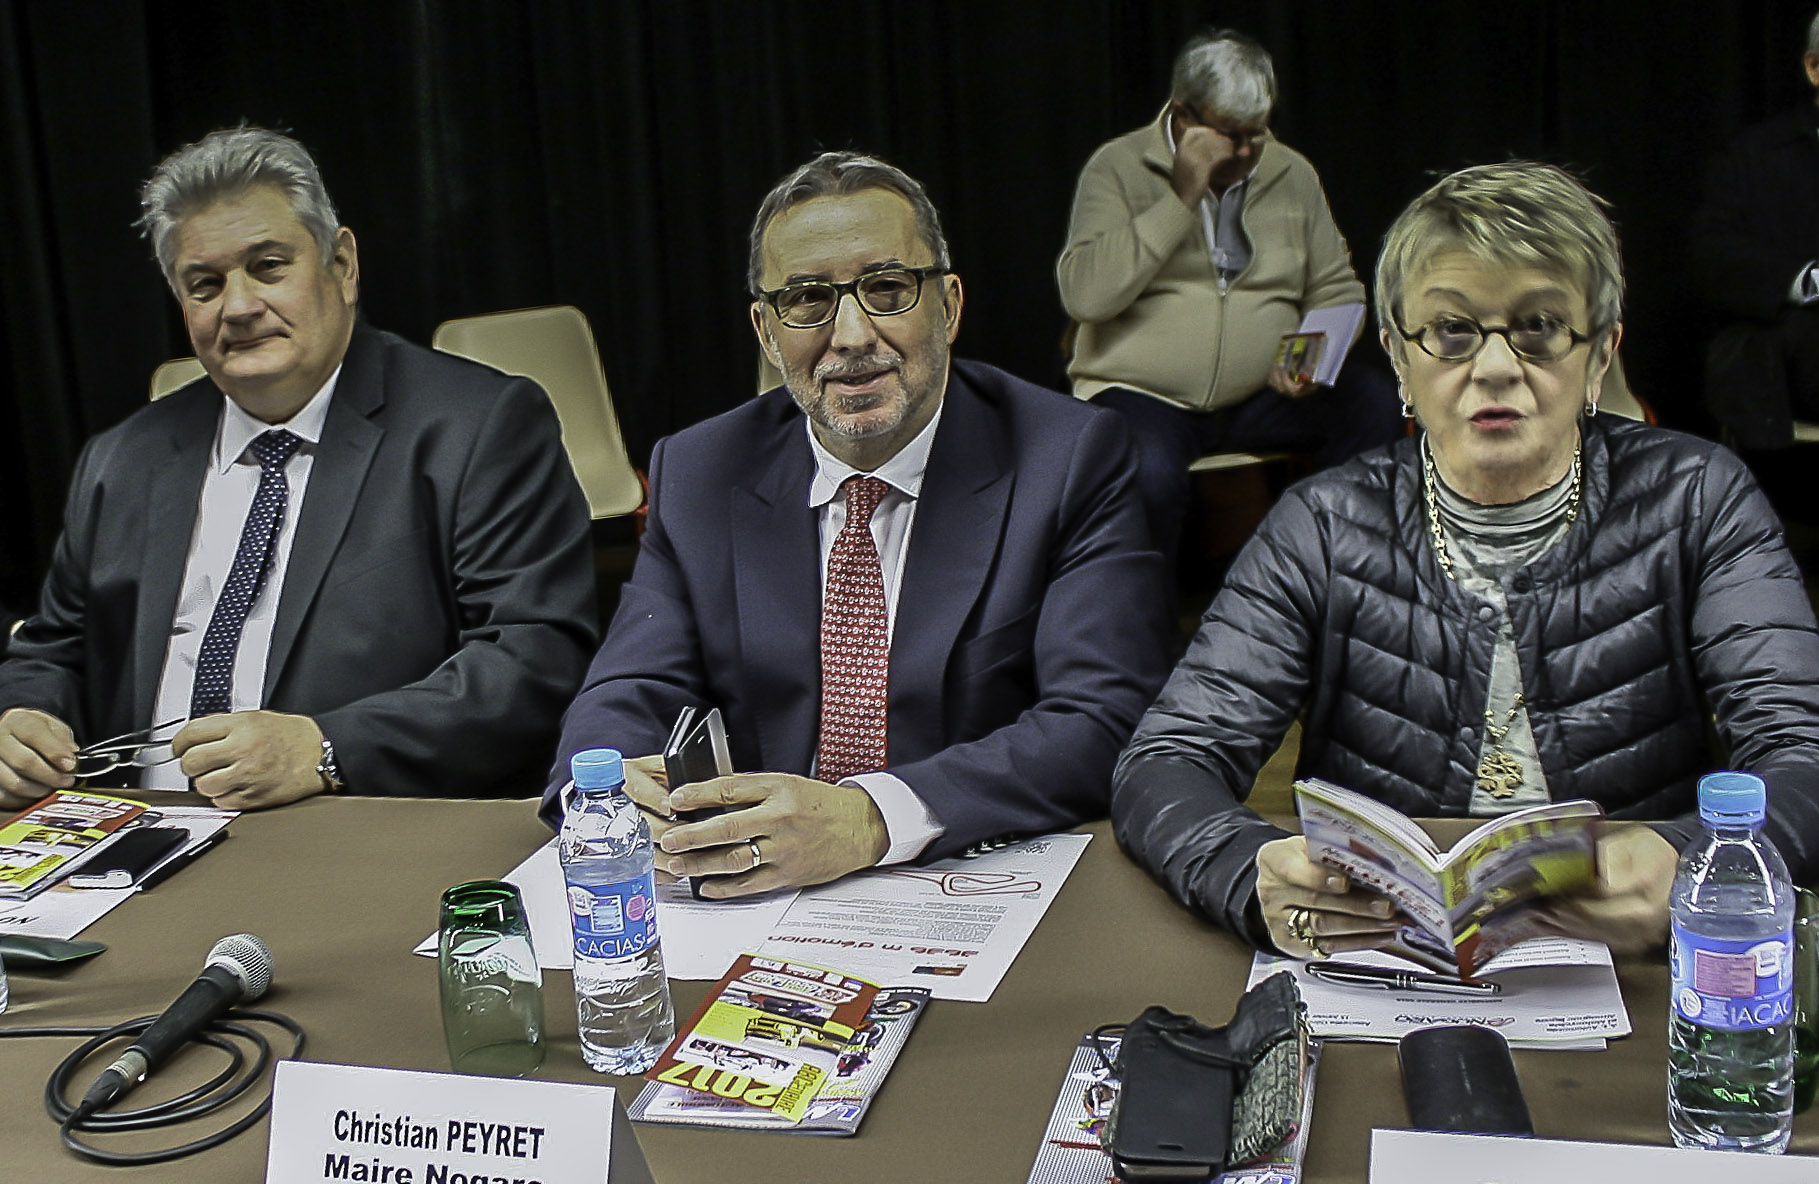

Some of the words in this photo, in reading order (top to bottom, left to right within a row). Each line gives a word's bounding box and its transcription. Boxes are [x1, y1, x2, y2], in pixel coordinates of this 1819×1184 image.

[657, 1061, 787, 1107] 2017
[334, 1109, 438, 1150] Christian
[447, 1120, 545, 1160] PEYRET
[323, 1153, 413, 1184] Maire
